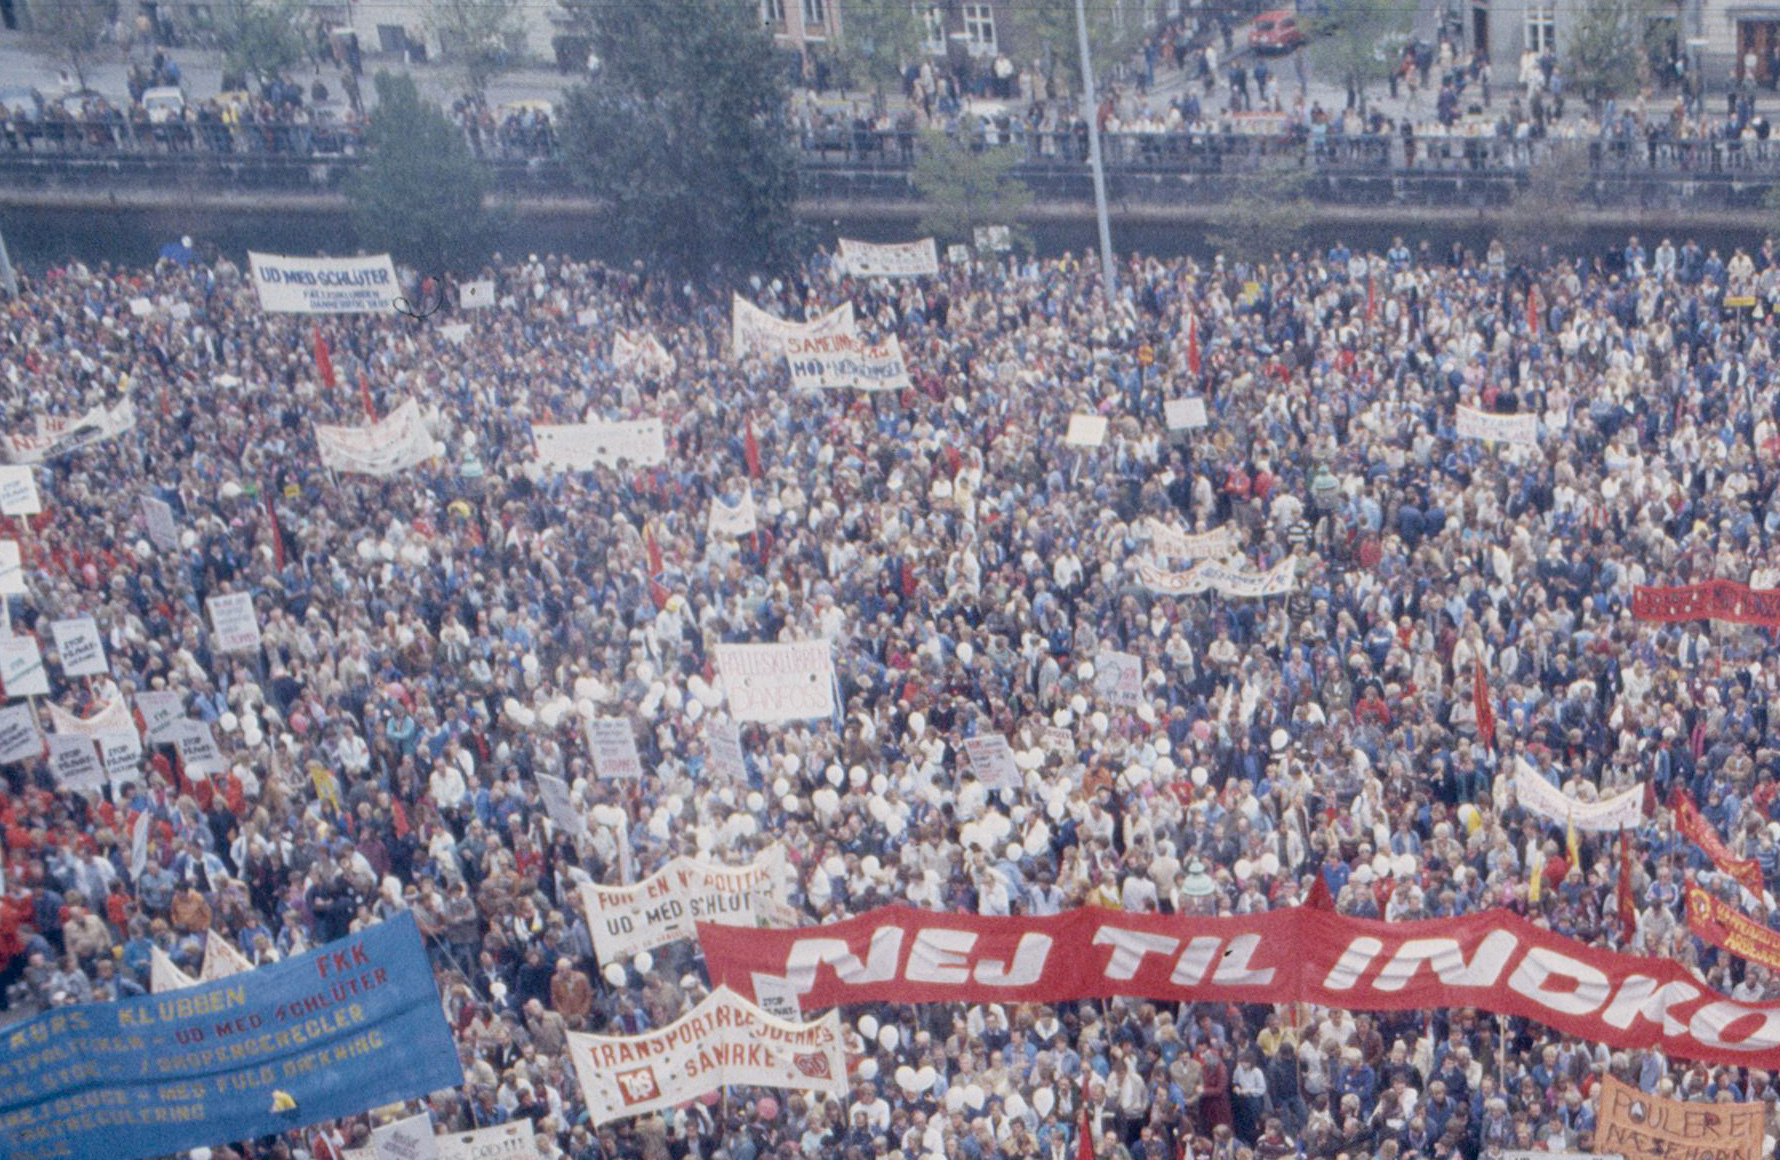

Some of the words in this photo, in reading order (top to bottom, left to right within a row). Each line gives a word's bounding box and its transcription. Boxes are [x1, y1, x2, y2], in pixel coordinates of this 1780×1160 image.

[259, 266, 282, 283] UD
[283, 269, 317, 286] MED
[793, 360, 825, 377] MOD
[734, 686, 828, 712] DANFOSS
[646, 876, 670, 900] EN
[703, 868, 772, 892] POLITIK
[606, 917, 635, 936] UD
[645, 898, 684, 925] MED
[314, 940, 370, 980] FKK
[786, 925, 1053, 995] NEJ
[1093, 925, 1275, 986] TIL
[117, 984, 248, 1027] KLUBBEN
[173, 1028, 205, 1046] UD
[213, 1013, 262, 1039] MED
[1612, 1088, 1682, 1137] POUL
